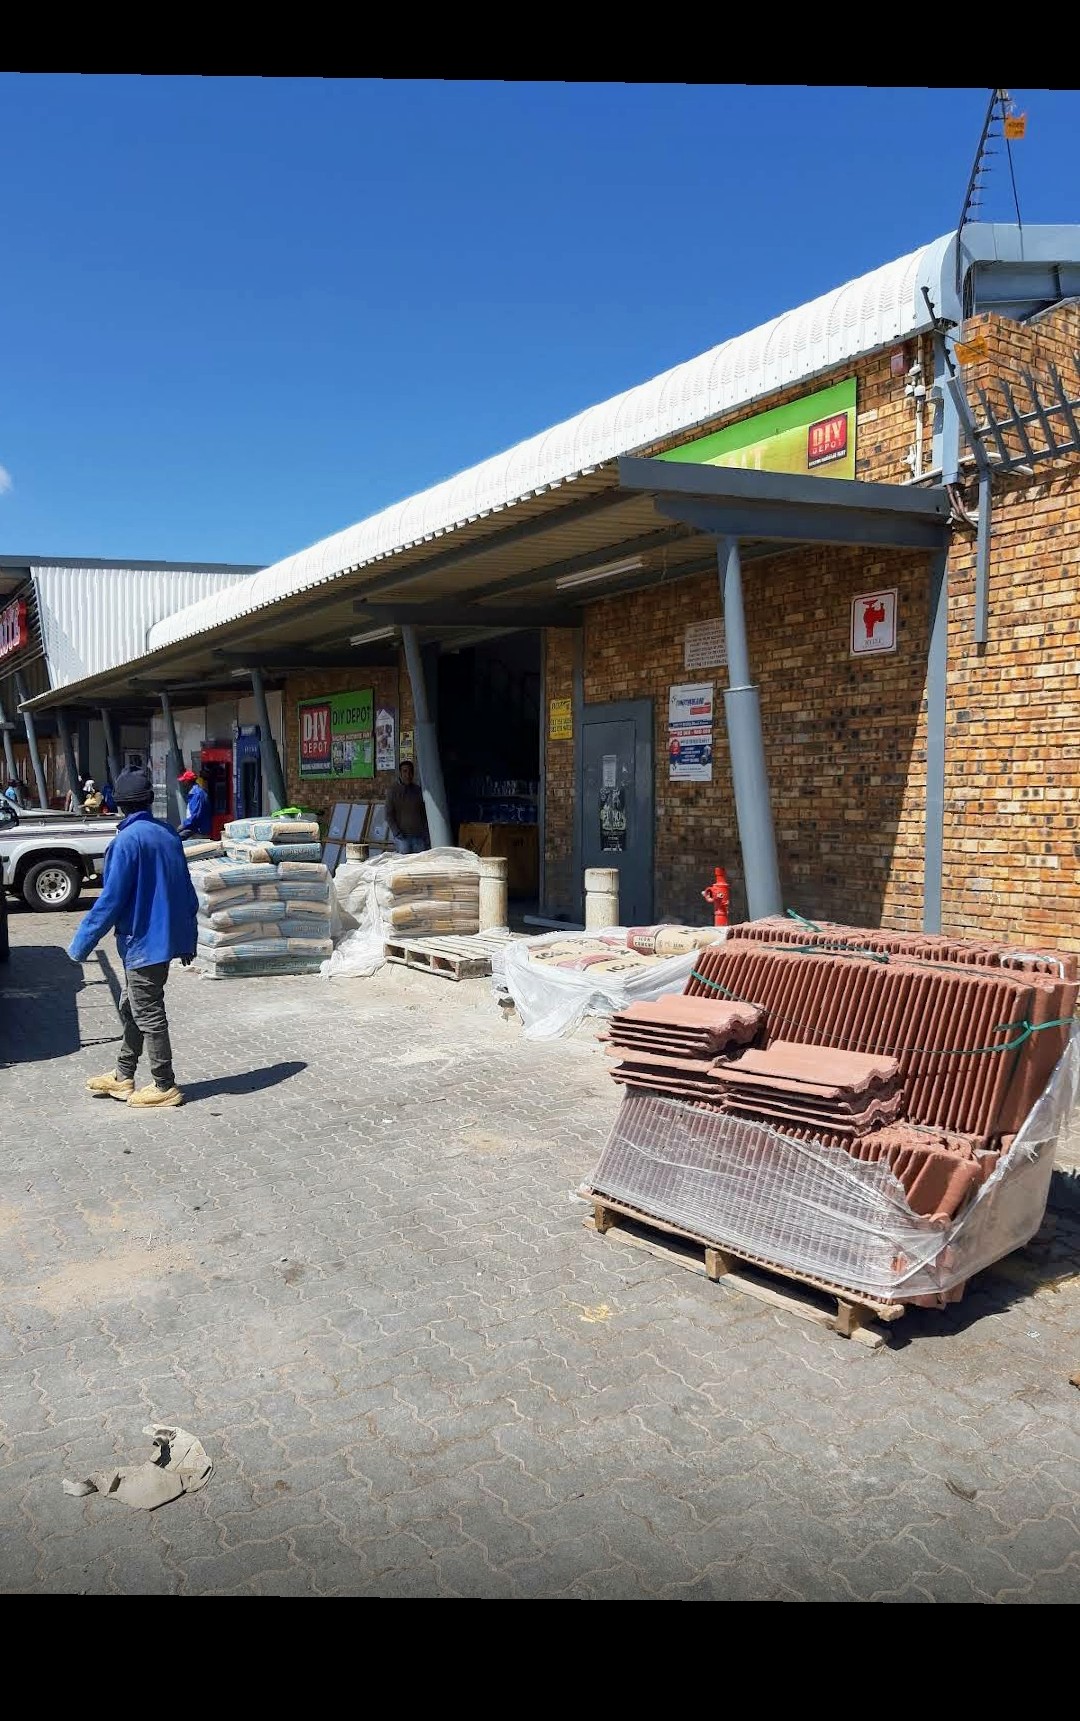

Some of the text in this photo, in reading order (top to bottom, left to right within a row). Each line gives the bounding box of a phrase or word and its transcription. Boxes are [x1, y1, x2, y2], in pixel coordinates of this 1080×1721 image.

[812, 420, 843, 447] DIY
[812, 440, 842, 455] DEPOT
[303, 711, 328, 741] DIY
[333, 706, 371, 726] DIY DEPOT
[303, 741, 328, 754] DEPOT
